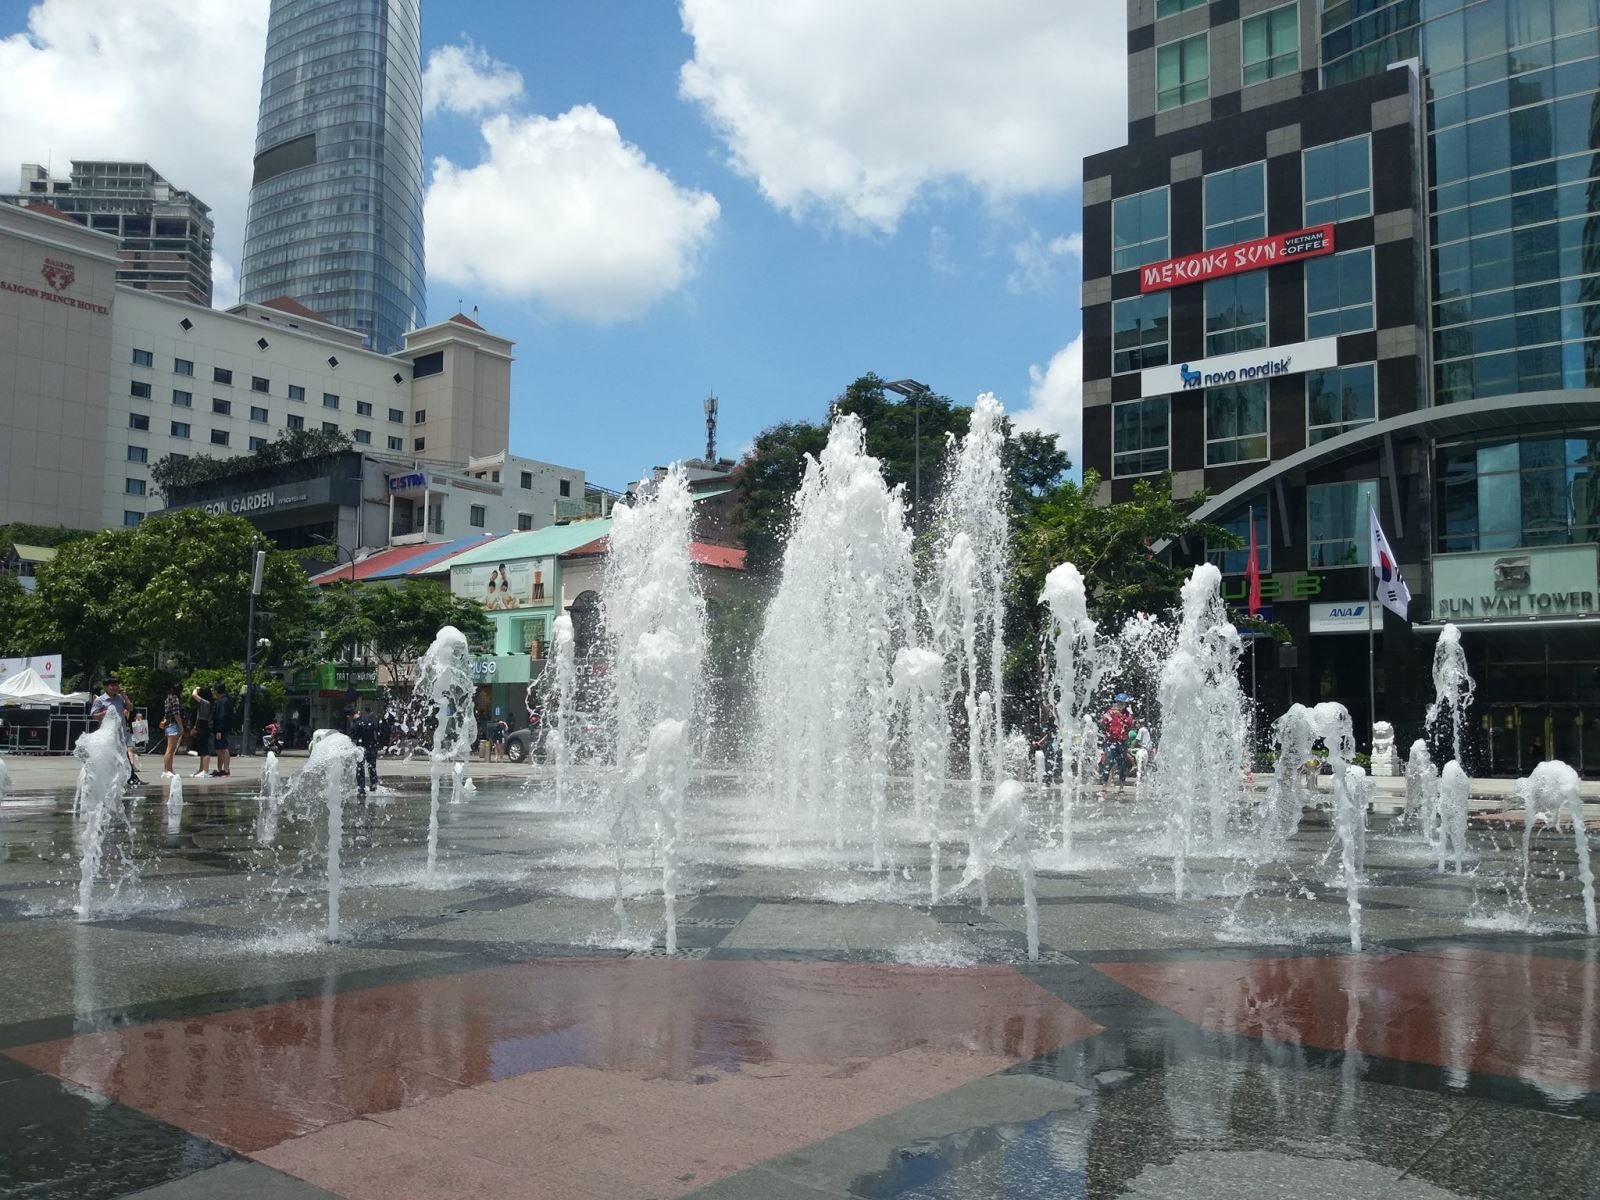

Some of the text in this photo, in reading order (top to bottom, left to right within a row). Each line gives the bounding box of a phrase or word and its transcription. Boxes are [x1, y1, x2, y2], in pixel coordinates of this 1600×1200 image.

[1279, 238, 1330, 257] COFFEE
[1285, 232, 1324, 246] VIETNAM
[1144, 241, 1276, 285] MEKONG SUN
[0, 280, 110, 316] SAIGON PRINCE HOTEL
[1204, 359, 1290, 386] novo nordisk
[231, 491, 275, 513] GARDEN
[1221, 576, 1322, 600] UBB
[1329, 608, 1353, 617] ANA
[1439, 591, 1592, 614] SUN WAH TOWER
